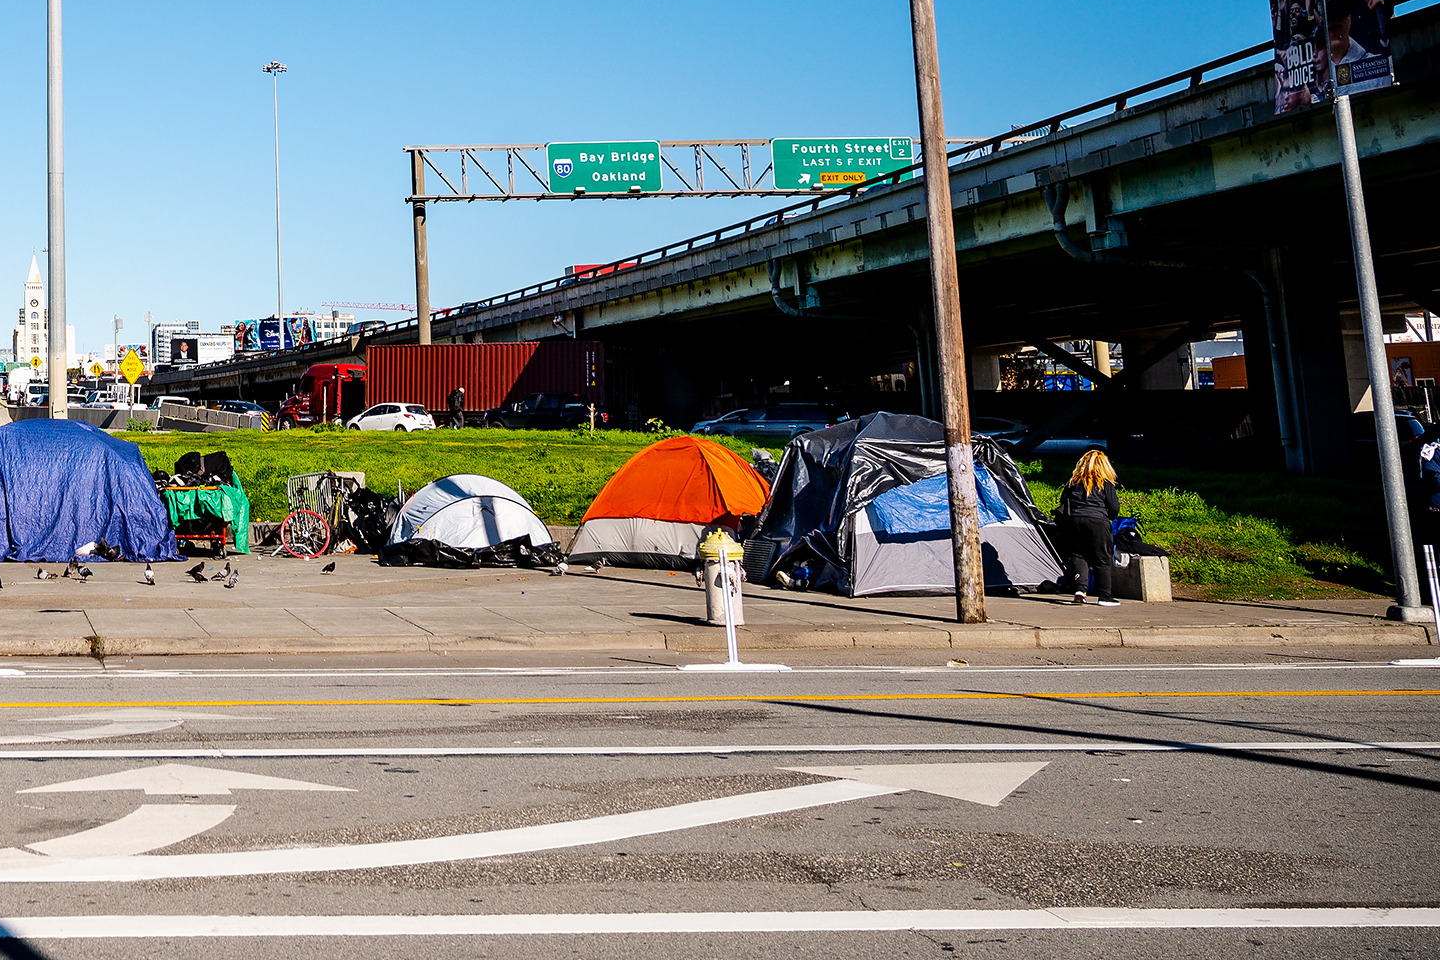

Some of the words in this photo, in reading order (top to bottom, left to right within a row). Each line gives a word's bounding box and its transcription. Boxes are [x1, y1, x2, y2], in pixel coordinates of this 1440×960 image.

[1286, 41, 1314, 70] BOLD
[1288, 64, 1315, 88] VOICE
[792, 143, 838, 154] Fourth
[845, 143, 889, 154] Street
[898, 148, 905, 156] 2
[580, 152, 605, 165] Bay
[611, 151, 655, 164] Bridge
[803, 158, 830, 167] LAST
[837, 158, 843, 166] S
[848, 158, 853, 166] F
[859, 158, 882, 166] EXIT
[556, 164, 570, 174] 80
[592, 171, 646, 182] Oakland
[821, 174, 839, 182] EXIT
[843, 174, 864, 182] ONLY
